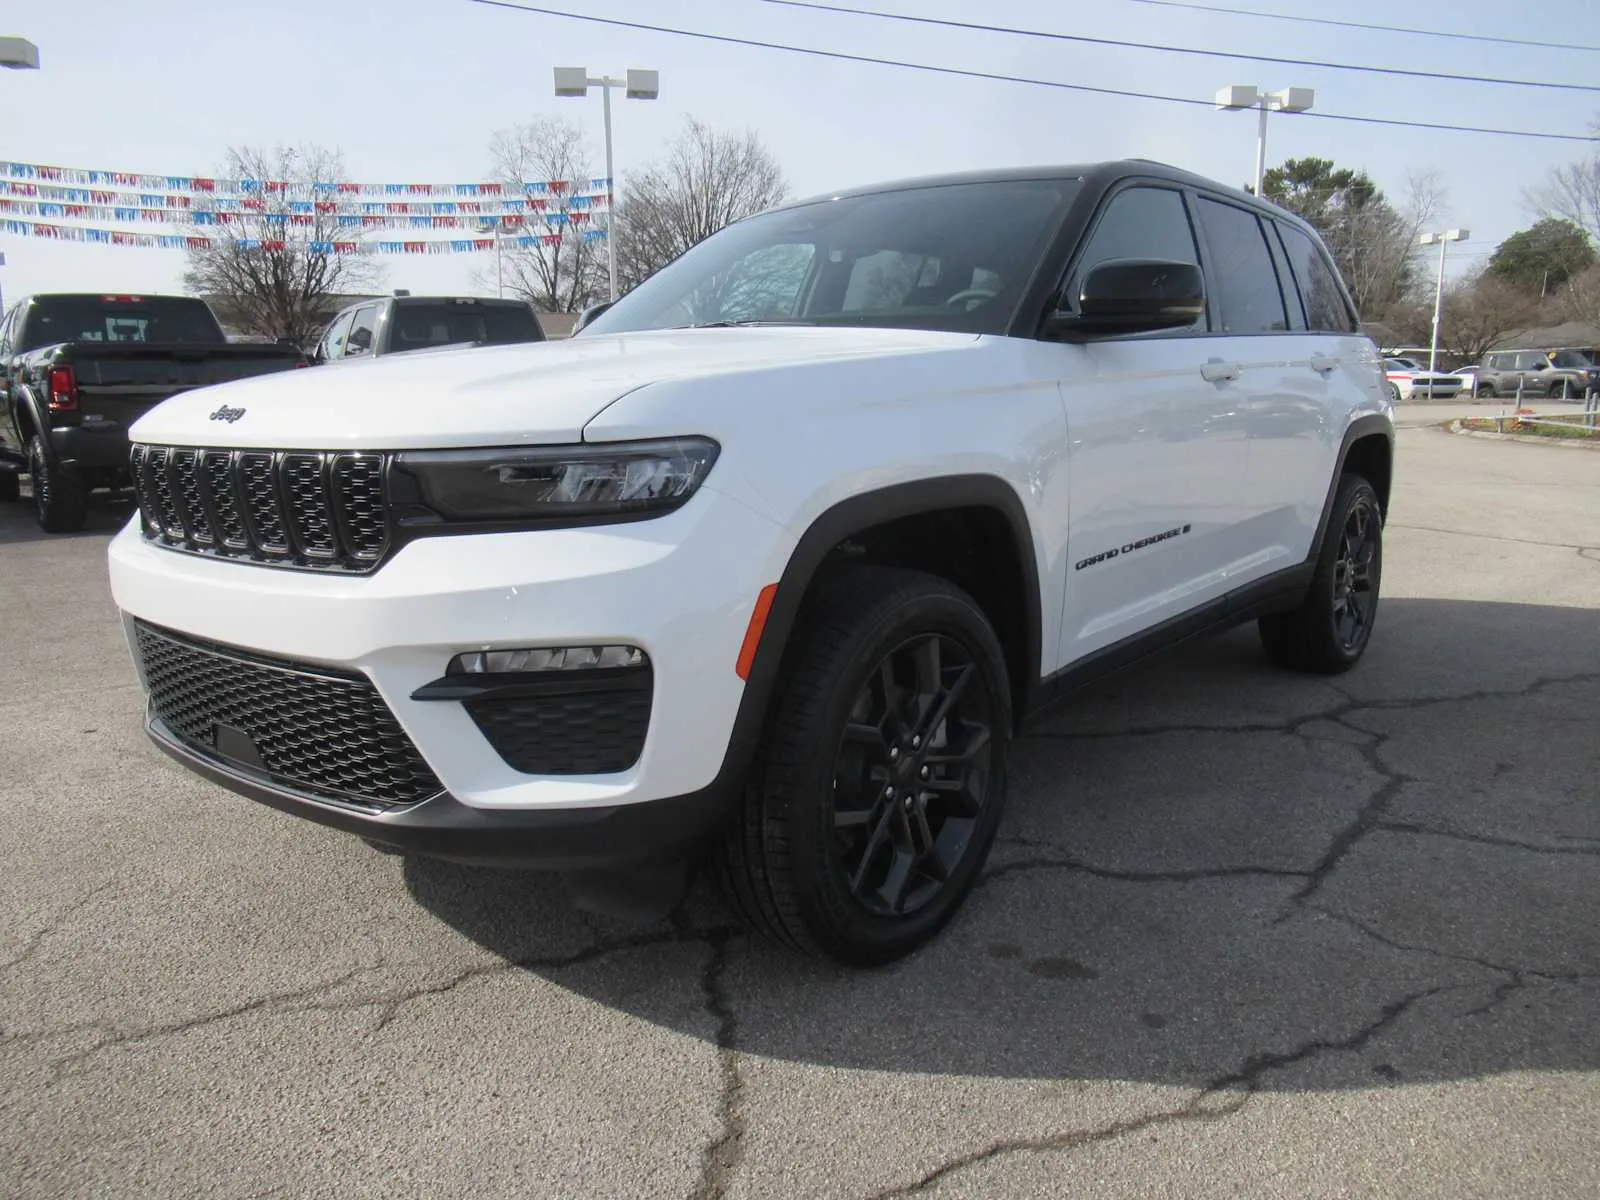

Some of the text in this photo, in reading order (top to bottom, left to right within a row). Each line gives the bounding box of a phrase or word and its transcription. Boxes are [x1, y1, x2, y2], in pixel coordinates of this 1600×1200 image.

[209, 404, 246, 424] Jeep
[1075, 527, 1181, 570] GRAND CHEROKEE
